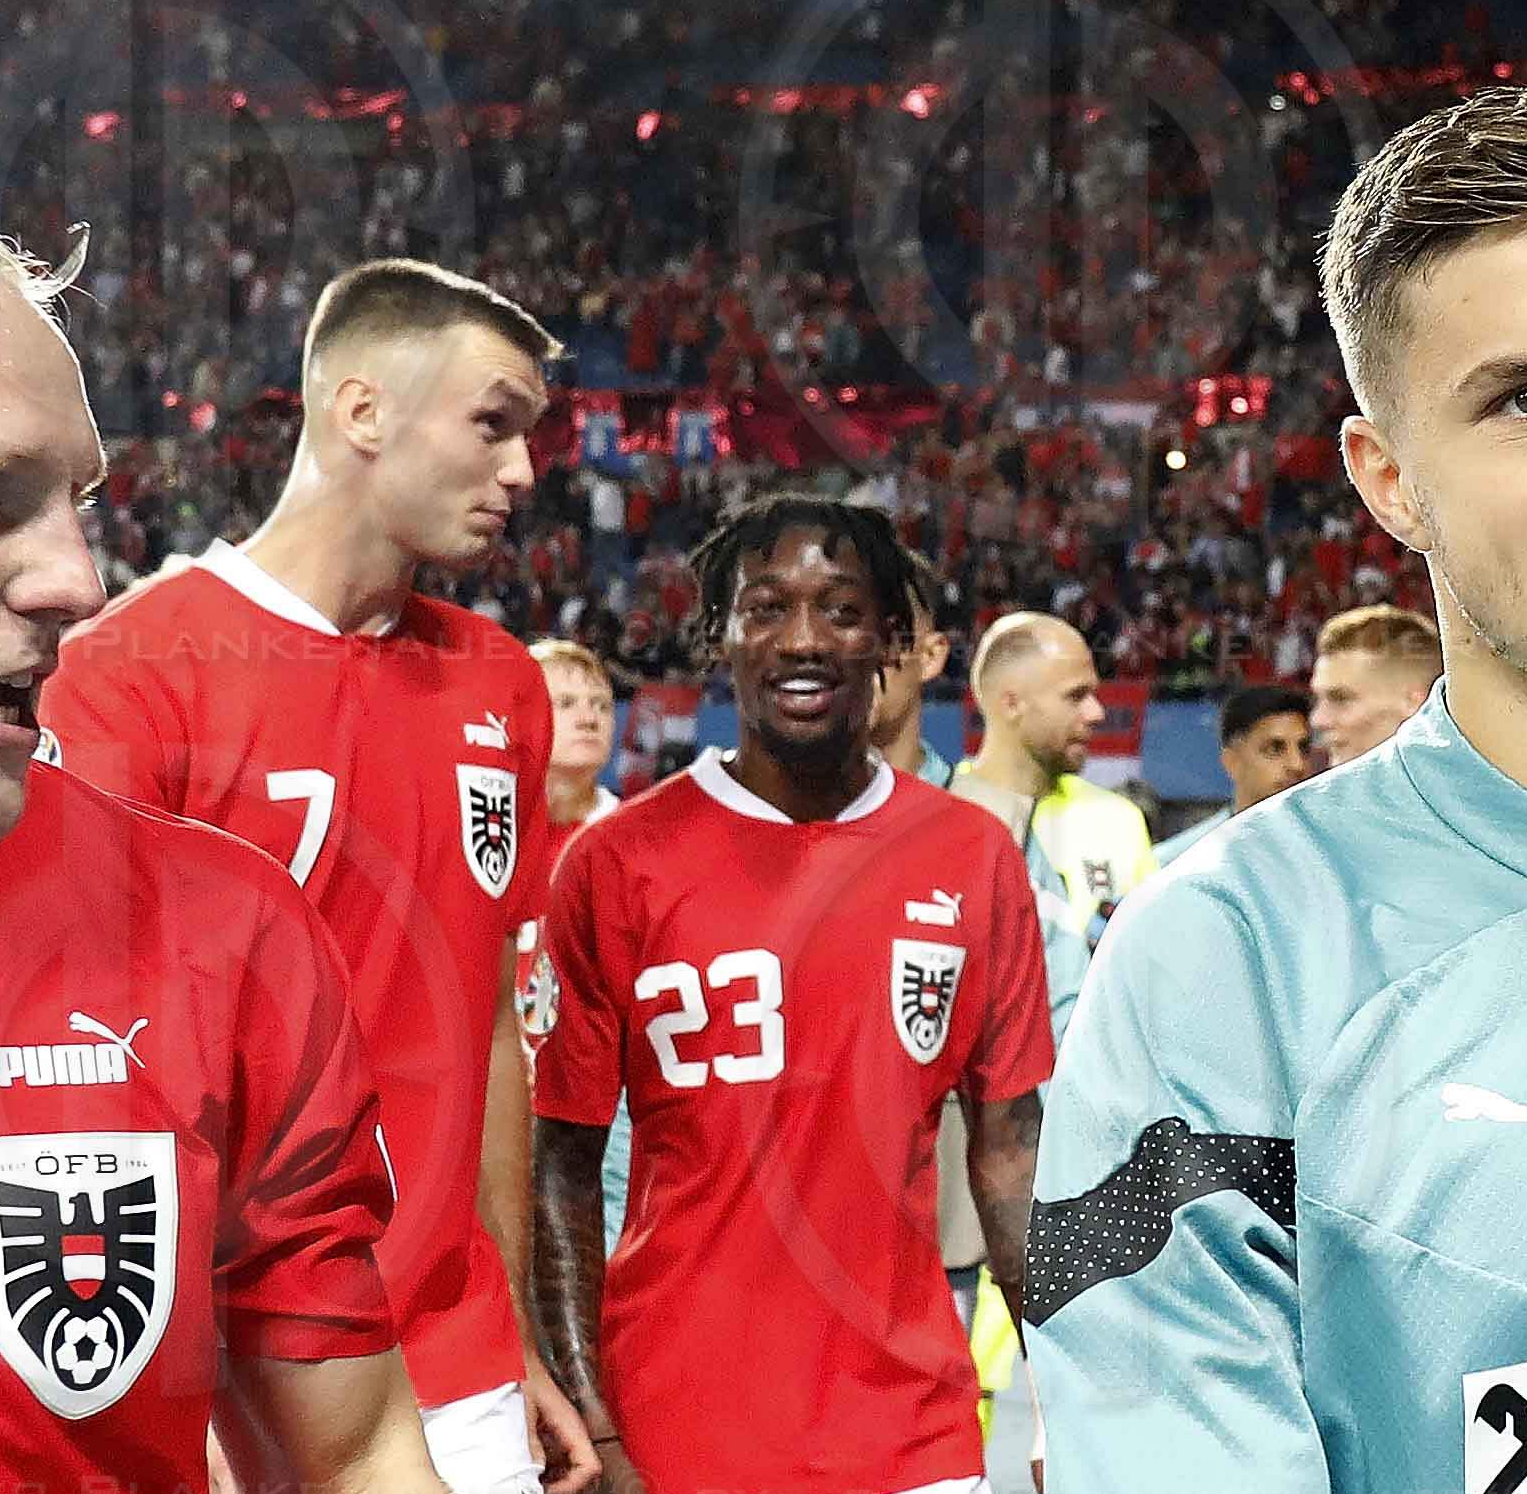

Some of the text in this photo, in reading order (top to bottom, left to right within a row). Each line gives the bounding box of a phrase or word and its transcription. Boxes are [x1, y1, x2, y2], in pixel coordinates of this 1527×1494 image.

[266, 767, 337, 887] 7
[634, 947, 786, 1088] 23
[35, 1150, 119, 1176] ÖFB
